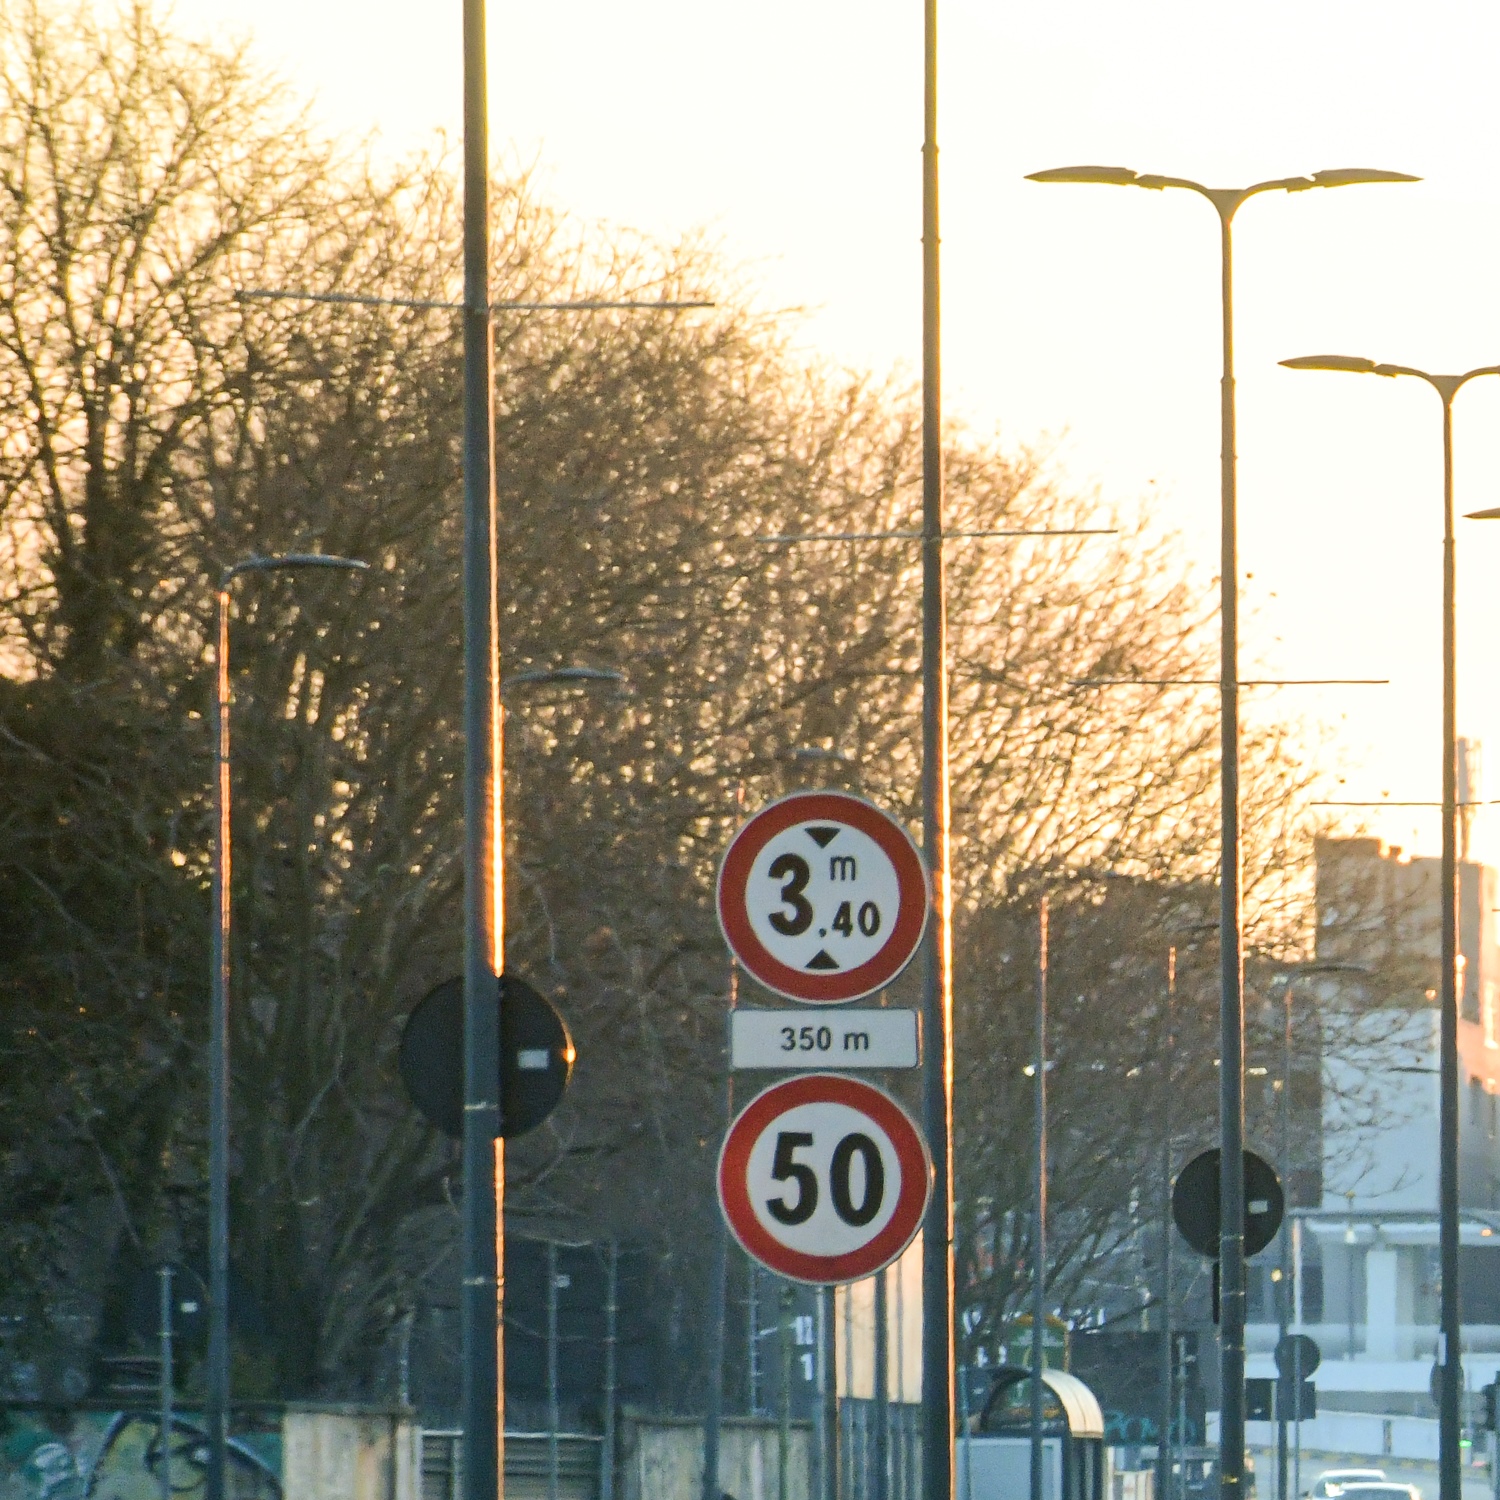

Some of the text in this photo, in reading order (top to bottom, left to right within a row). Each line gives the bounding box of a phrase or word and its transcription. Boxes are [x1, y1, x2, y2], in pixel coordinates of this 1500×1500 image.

[830, 855, 856, 881] m
[781, 1026, 869, 1051] 350 m
[766, 1132, 884, 1227] 50
